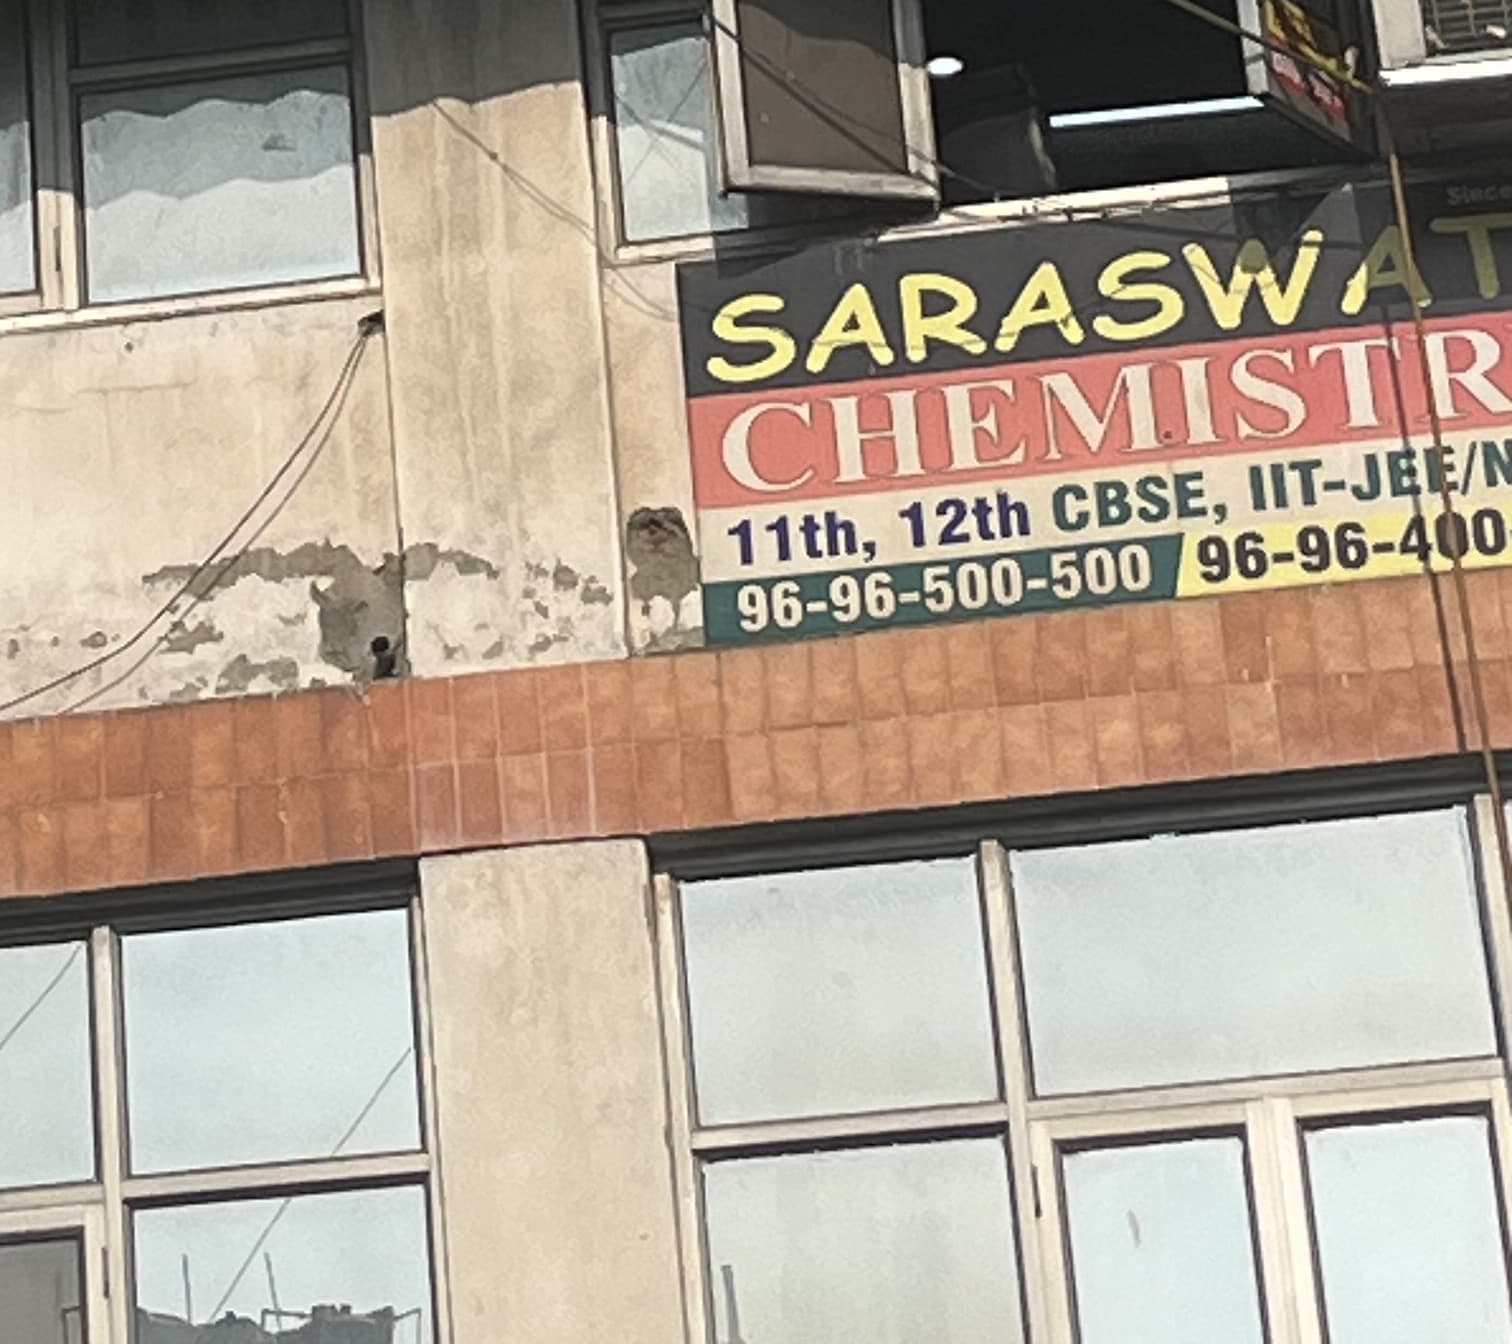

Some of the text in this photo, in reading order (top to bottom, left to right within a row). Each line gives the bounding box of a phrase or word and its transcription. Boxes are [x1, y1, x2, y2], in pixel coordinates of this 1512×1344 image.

[707, 213, 1512, 382] SARASWAT
[719, 326, 1512, 493] CHEMISTR
[728, 510, 877, 567] 11th,
[899, 492, 1031, 548] 12th
[1051, 469, 1227, 532] CBSE,
[737, 543, 1152, 633] 96-96-500-500
